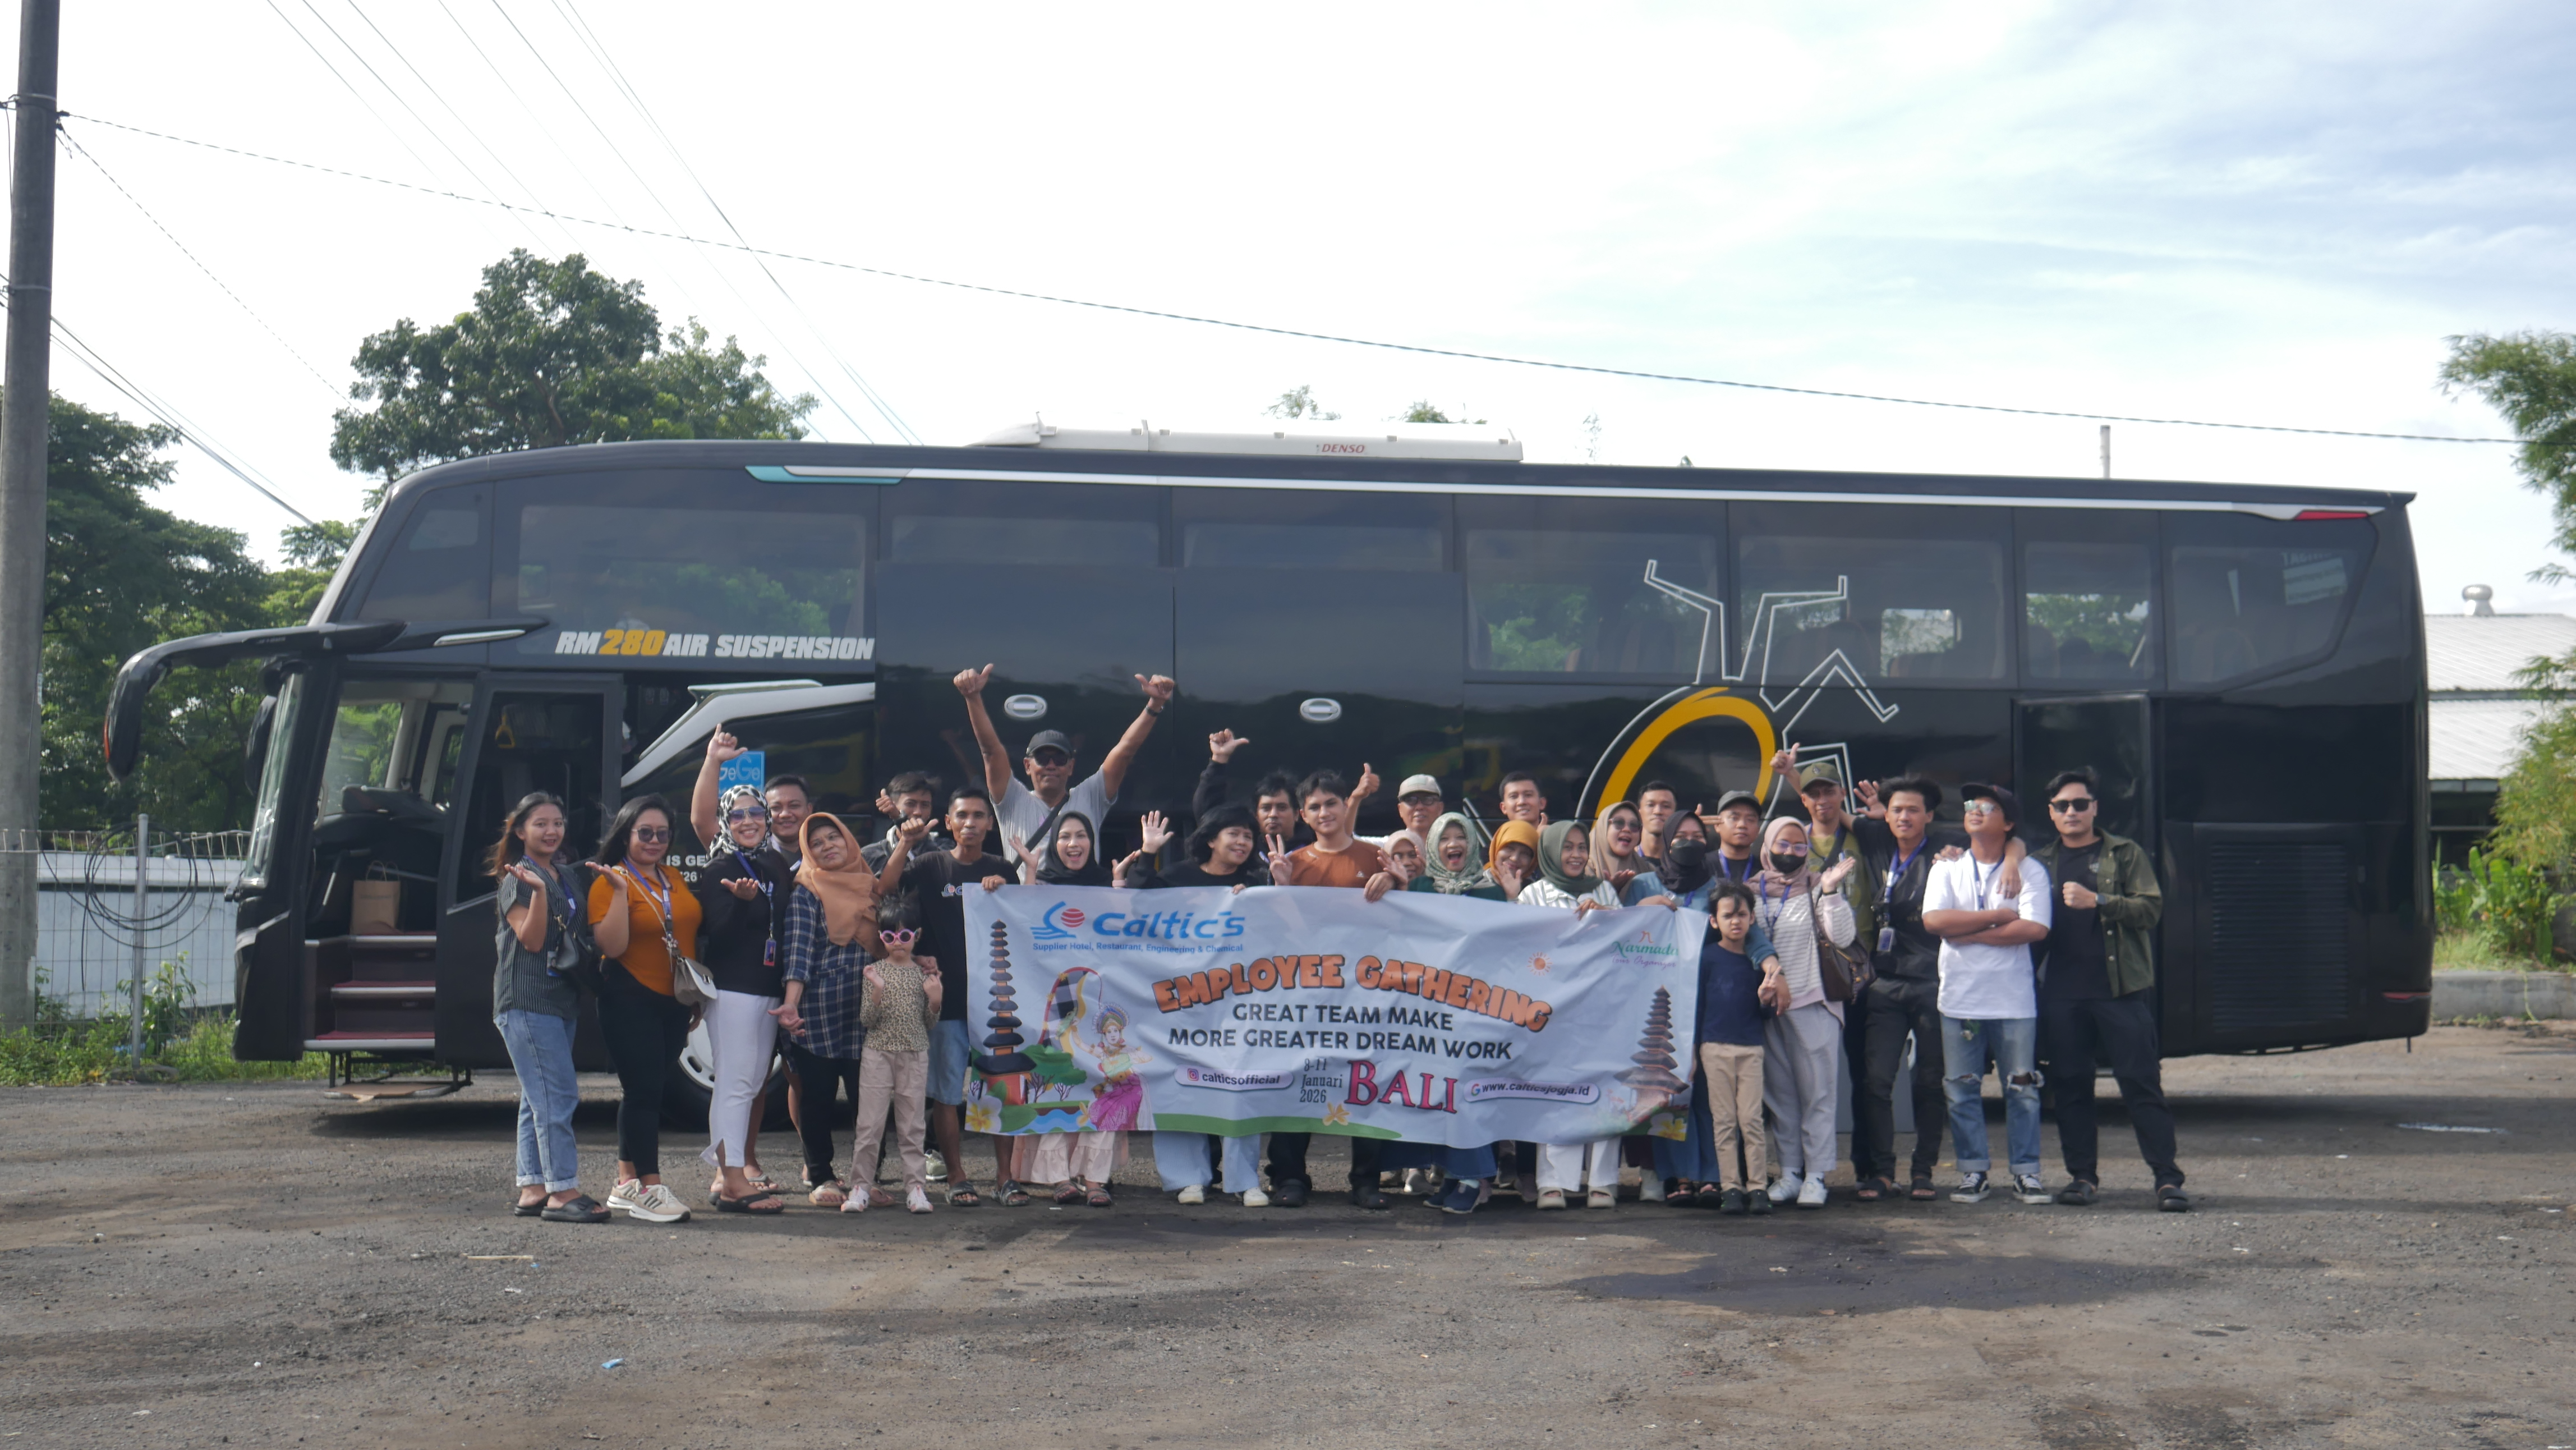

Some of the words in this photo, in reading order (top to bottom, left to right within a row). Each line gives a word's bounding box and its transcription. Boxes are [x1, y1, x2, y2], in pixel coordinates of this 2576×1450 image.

[1322, 444, 1365, 453] DENSO
[599, 629, 666, 656] 280
[663, 634, 709, 657] AIR
[715, 635, 875, 659] SUSPENSION
[1033, 943, 1067, 952] Supplier
[1070, 942, 1093, 951] Hotel,
[1096, 942, 1143, 952] Restaurant,
[1146, 944, 1195, 954] Engineering
[1207, 944, 1243, 952] Chemical
[1610, 940, 1678, 957] Narmada
[1152, 955, 1345, 1013] EMPLOYEE
[1355, 955, 1553, 1033] GATHERING
[1233, 1003, 1308, 1022] GREAT
[1315, 1005, 1381, 1024] TEAM
[1387, 1006, 1453, 1031] MAKE
[1168, 1028, 1236, 1047] MORE
[1243, 1029, 1349, 1049] GREATER
[1356, 1031, 1436, 1054] DREAM
[1443, 1039, 1512, 1059] WORK
[1304, 1058, 1327, 1072] 8-11
[1202, 1073, 1280, 1085] calticsofficial
[1301, 1074, 1342, 1089] Januari
[1344, 1059, 1457, 1113] BALI
[1300, 1089, 1327, 1103] 2026
[1482, 1083, 1590, 1096] www.calticsjogja.id
